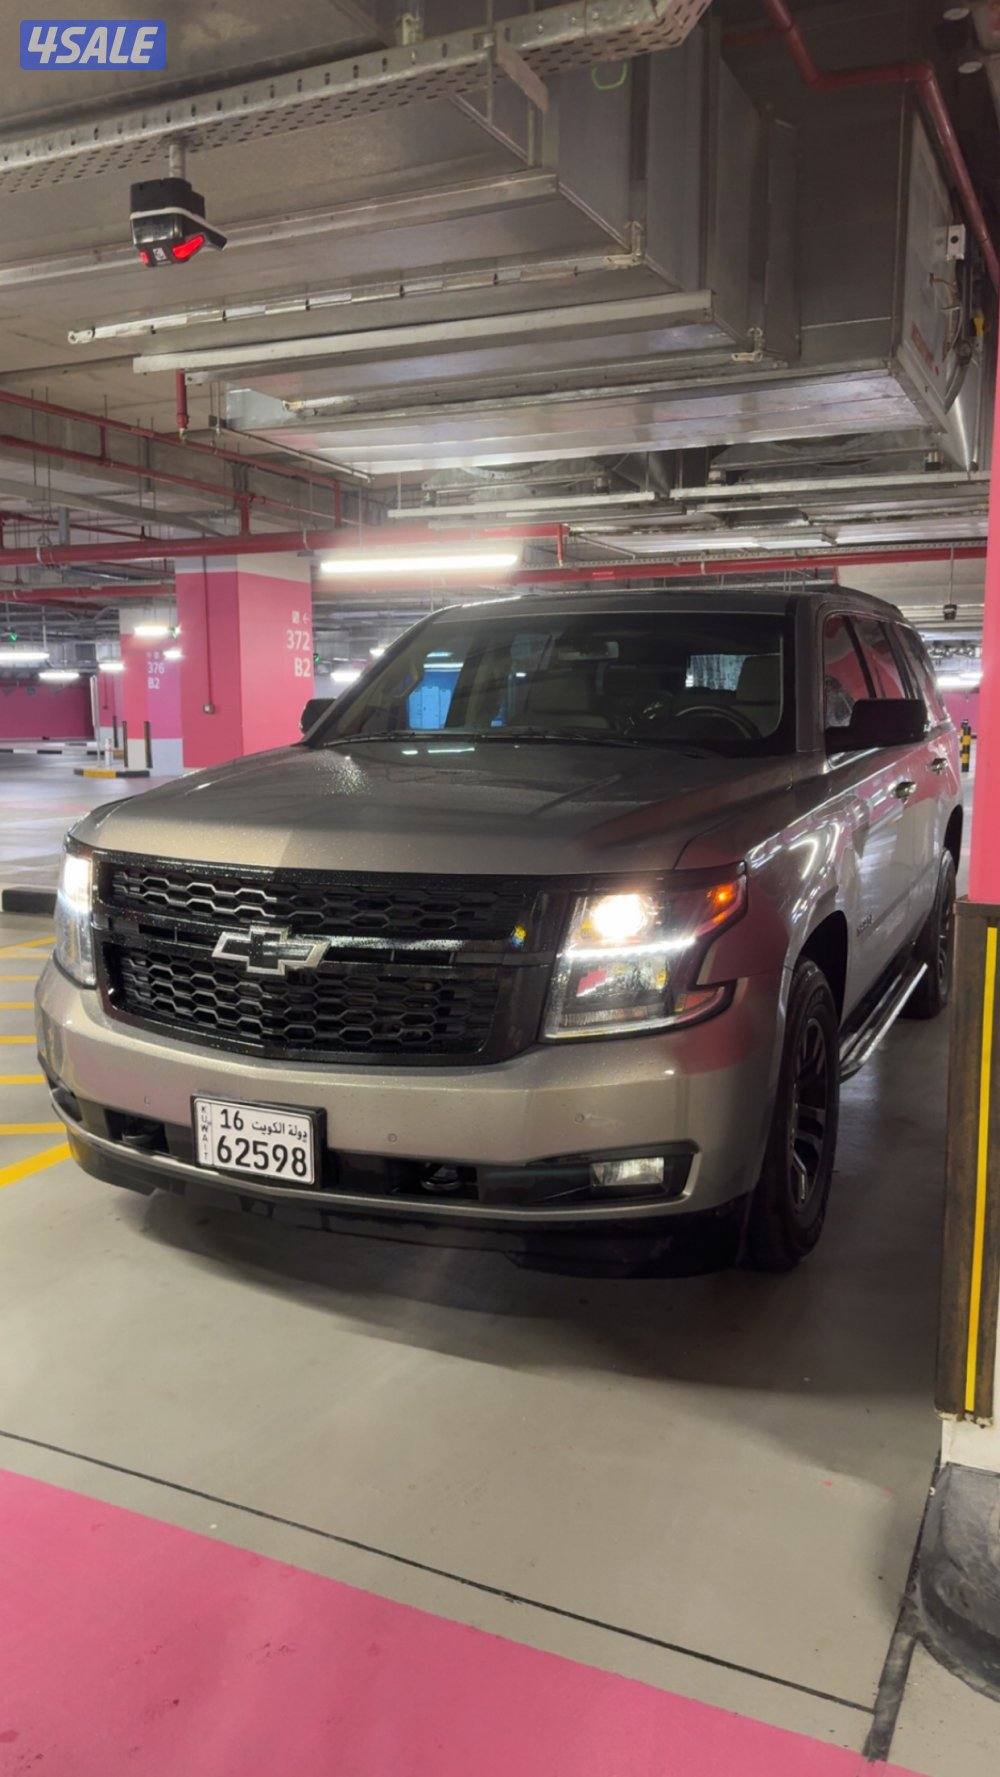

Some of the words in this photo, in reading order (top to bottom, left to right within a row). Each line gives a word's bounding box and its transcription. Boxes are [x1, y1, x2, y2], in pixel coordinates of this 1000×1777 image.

[286, 629, 311, 651] 372
[294, 656, 311, 678] B2
[147, 677, 160, 690] B2
[220, 1108, 244, 1131] 16
[251, 1120, 285, 1136] الكويت
[200, 1105, 209, 1160] KUWAIT
[288, 1124, 308, 1141] دولة
[217, 1135, 307, 1178] 62598
